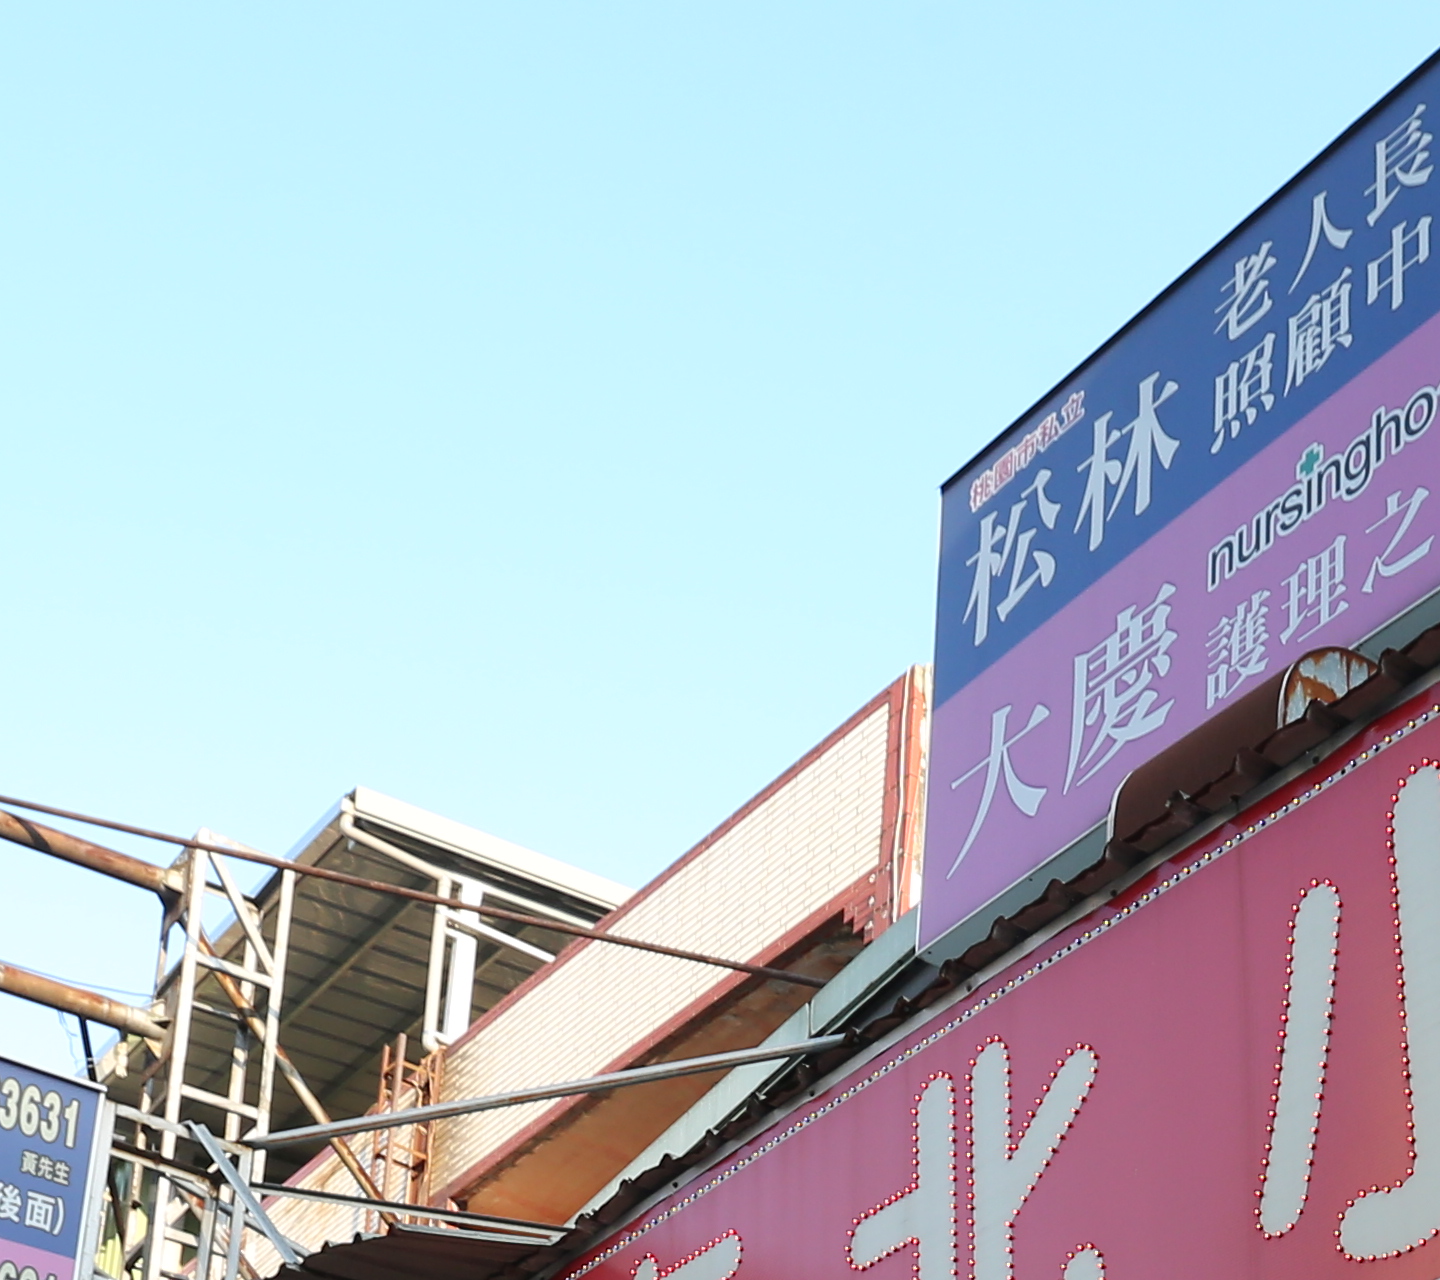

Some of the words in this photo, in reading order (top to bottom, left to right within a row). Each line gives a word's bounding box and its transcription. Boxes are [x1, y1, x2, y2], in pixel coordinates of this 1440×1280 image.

[963, 375, 1179, 647] 松林
[968, 389, 1086, 512] 桃園市私立
[944, 582, 1179, 879] 大慶
[21, 1151, 72, 1184] 黃先生
